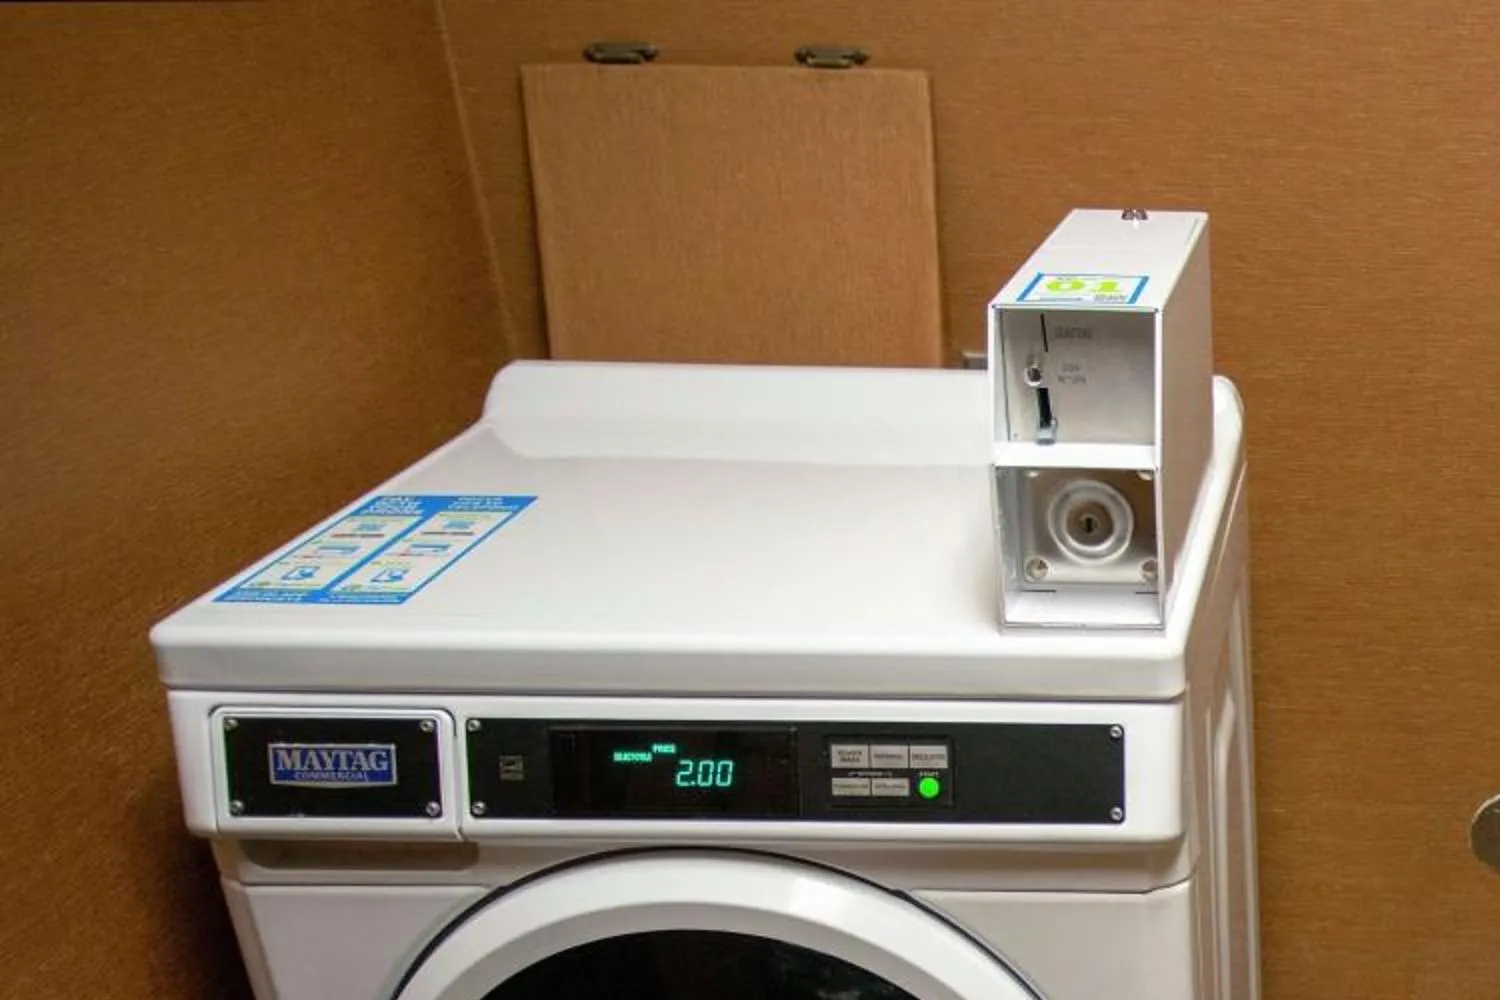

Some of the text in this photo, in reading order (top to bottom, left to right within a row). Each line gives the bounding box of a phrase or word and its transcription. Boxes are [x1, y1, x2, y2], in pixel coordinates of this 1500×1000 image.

[276, 749, 389, 771] MAYTAG
[294, 771, 369, 782] COMMERCIAL
[675, 760, 734, 787] 2.00
